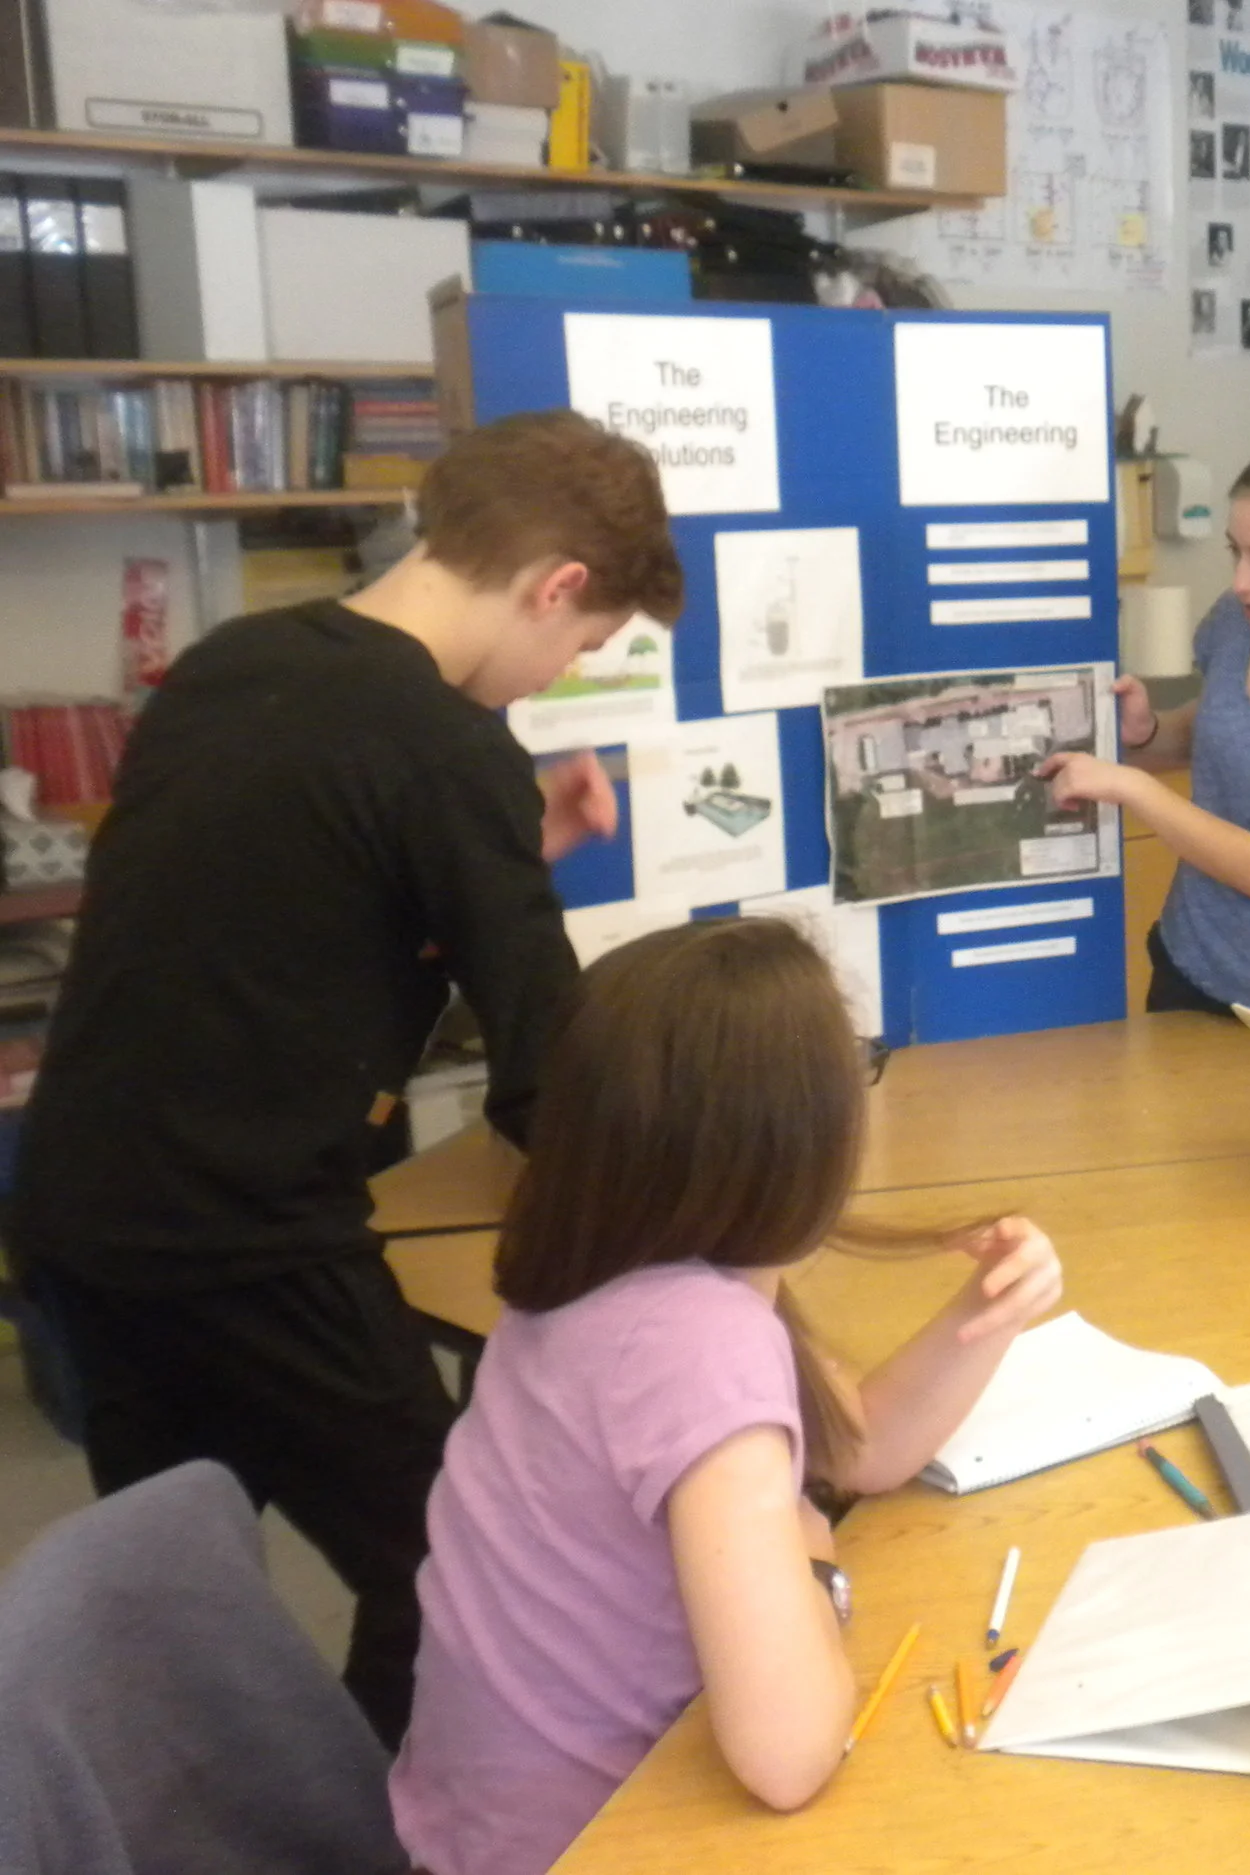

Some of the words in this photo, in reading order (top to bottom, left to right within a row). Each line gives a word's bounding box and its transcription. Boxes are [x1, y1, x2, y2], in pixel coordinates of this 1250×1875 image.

[653, 361, 703, 387] The
[983, 384, 1030, 410] The
[607, 401, 748, 434] Engineering
[934, 420, 1078, 451] Engineering
[654, 442, 736, 468] lutions
